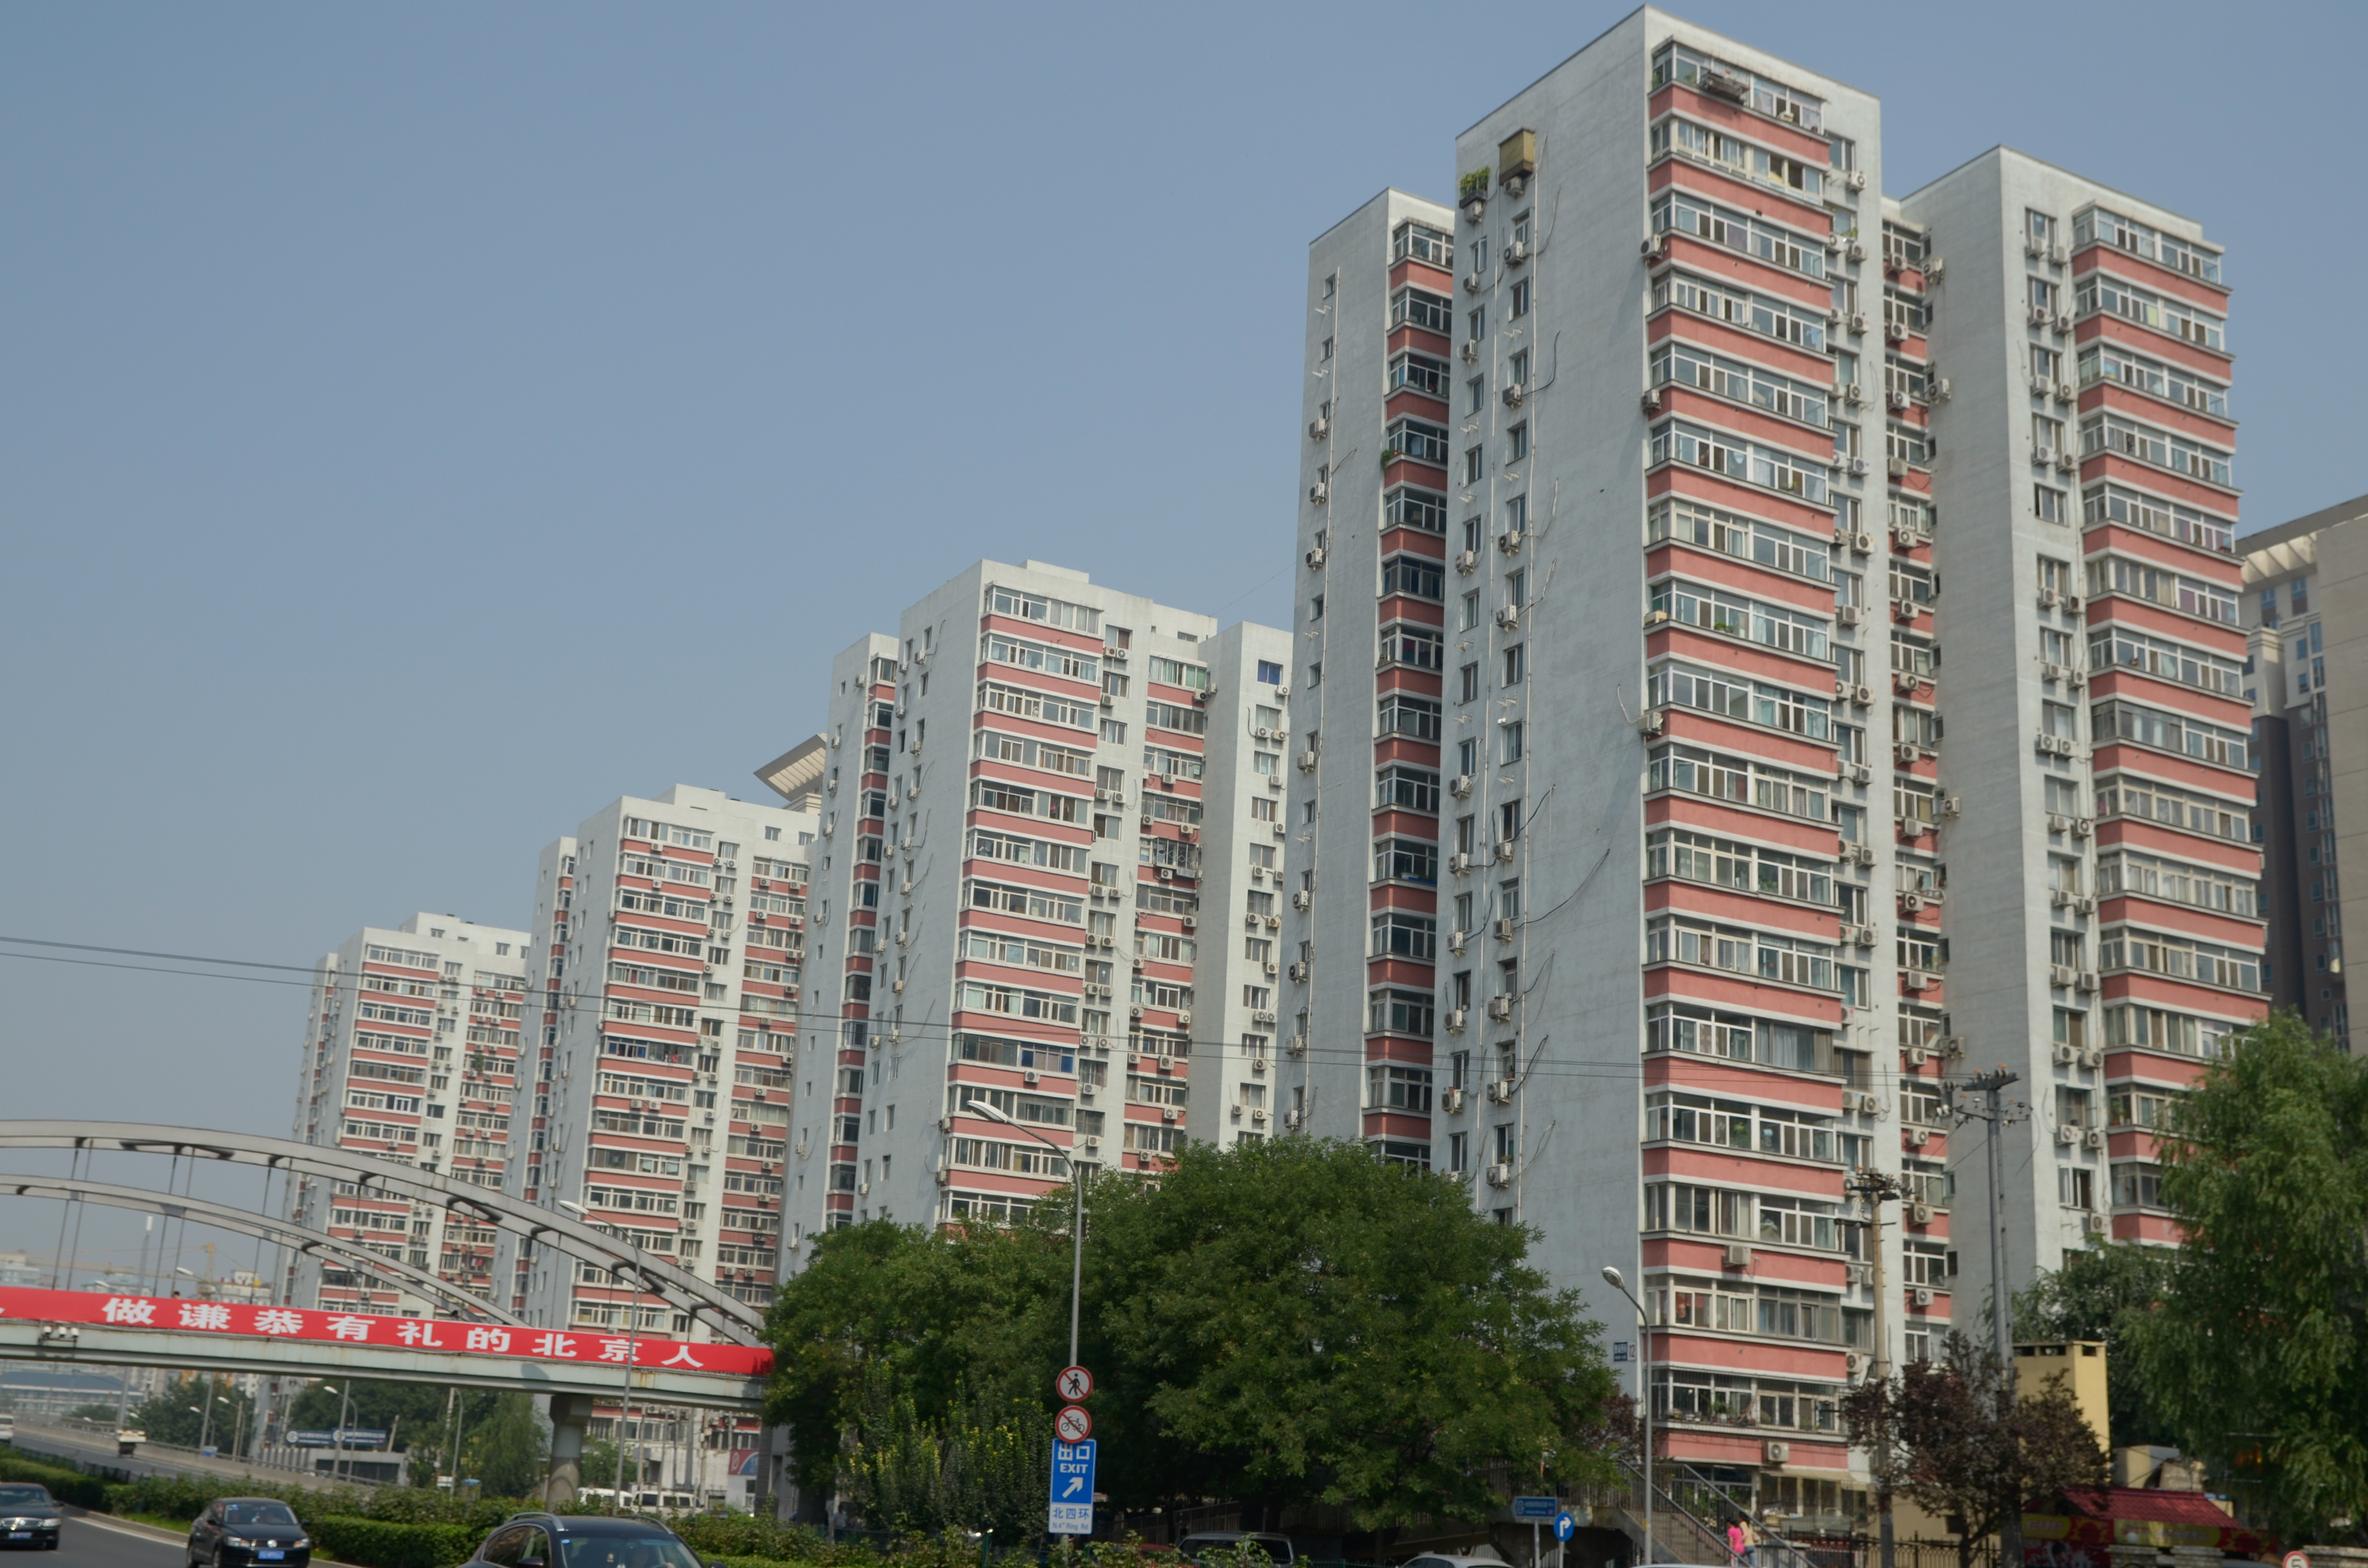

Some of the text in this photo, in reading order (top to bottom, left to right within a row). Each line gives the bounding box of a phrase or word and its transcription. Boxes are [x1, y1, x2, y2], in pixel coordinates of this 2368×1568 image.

[102, 1297, 704, 1368] 做谦恭有礼的北京人
[1629, 1345, 1635, 1358] 12
[1058, 1443, 1090, 1461] 出口
[1060, 1463, 1088, 1474] EXIT
[1053, 1507, 1089, 1520] 北四环
[1066, 1522, 1078, 1531] Ring
